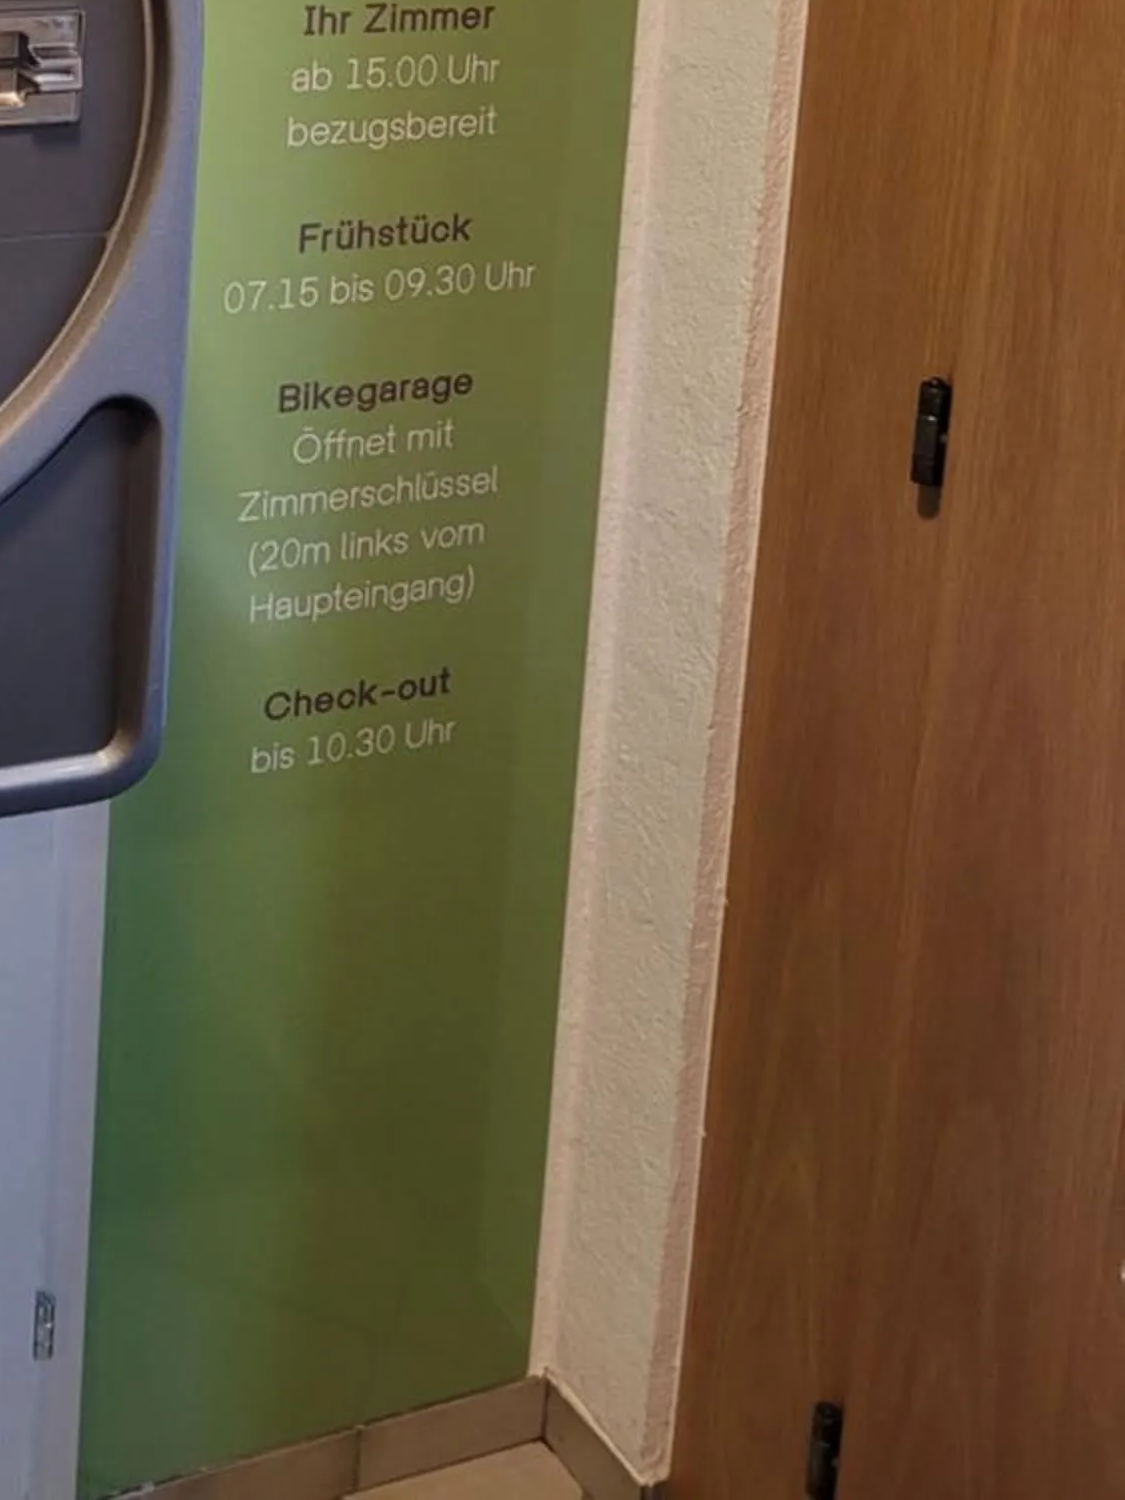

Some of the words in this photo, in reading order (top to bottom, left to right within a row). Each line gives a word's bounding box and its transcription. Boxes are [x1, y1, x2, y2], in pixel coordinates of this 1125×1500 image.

[303, 5, 351, 36] Ihr
[363, 3, 496, 34] Zimmer
[291, 62, 332, 93] ab
[346, 54, 438, 90] 15.00
[447, 52, 500, 83] Uhr
[287, 105, 497, 150] bezugsbereit
[299, 213, 473, 254] Frühstück
[224, 276, 319, 314] 07.15
[330, 273, 374, 305] bis
[385, 263, 476, 301] 09.30
[484, 261, 536, 291] Uhr
[278, 373, 474, 414] Bikegarage
[293, 426, 396, 464] Öffnet
[407, 419, 454, 449] mit
[238, 466, 498, 523] Zimmerschlüssel
[248, 537, 330, 576] (20m
[341, 530, 409, 560] links
[420, 521, 485, 549] vom
[250, 565, 475, 623] Haupteingang)
[264, 666, 451, 721] Check-out
[251, 745, 295, 774] bis
[307, 724, 395, 766] 10.30
[405, 718, 456, 749] Uhr
